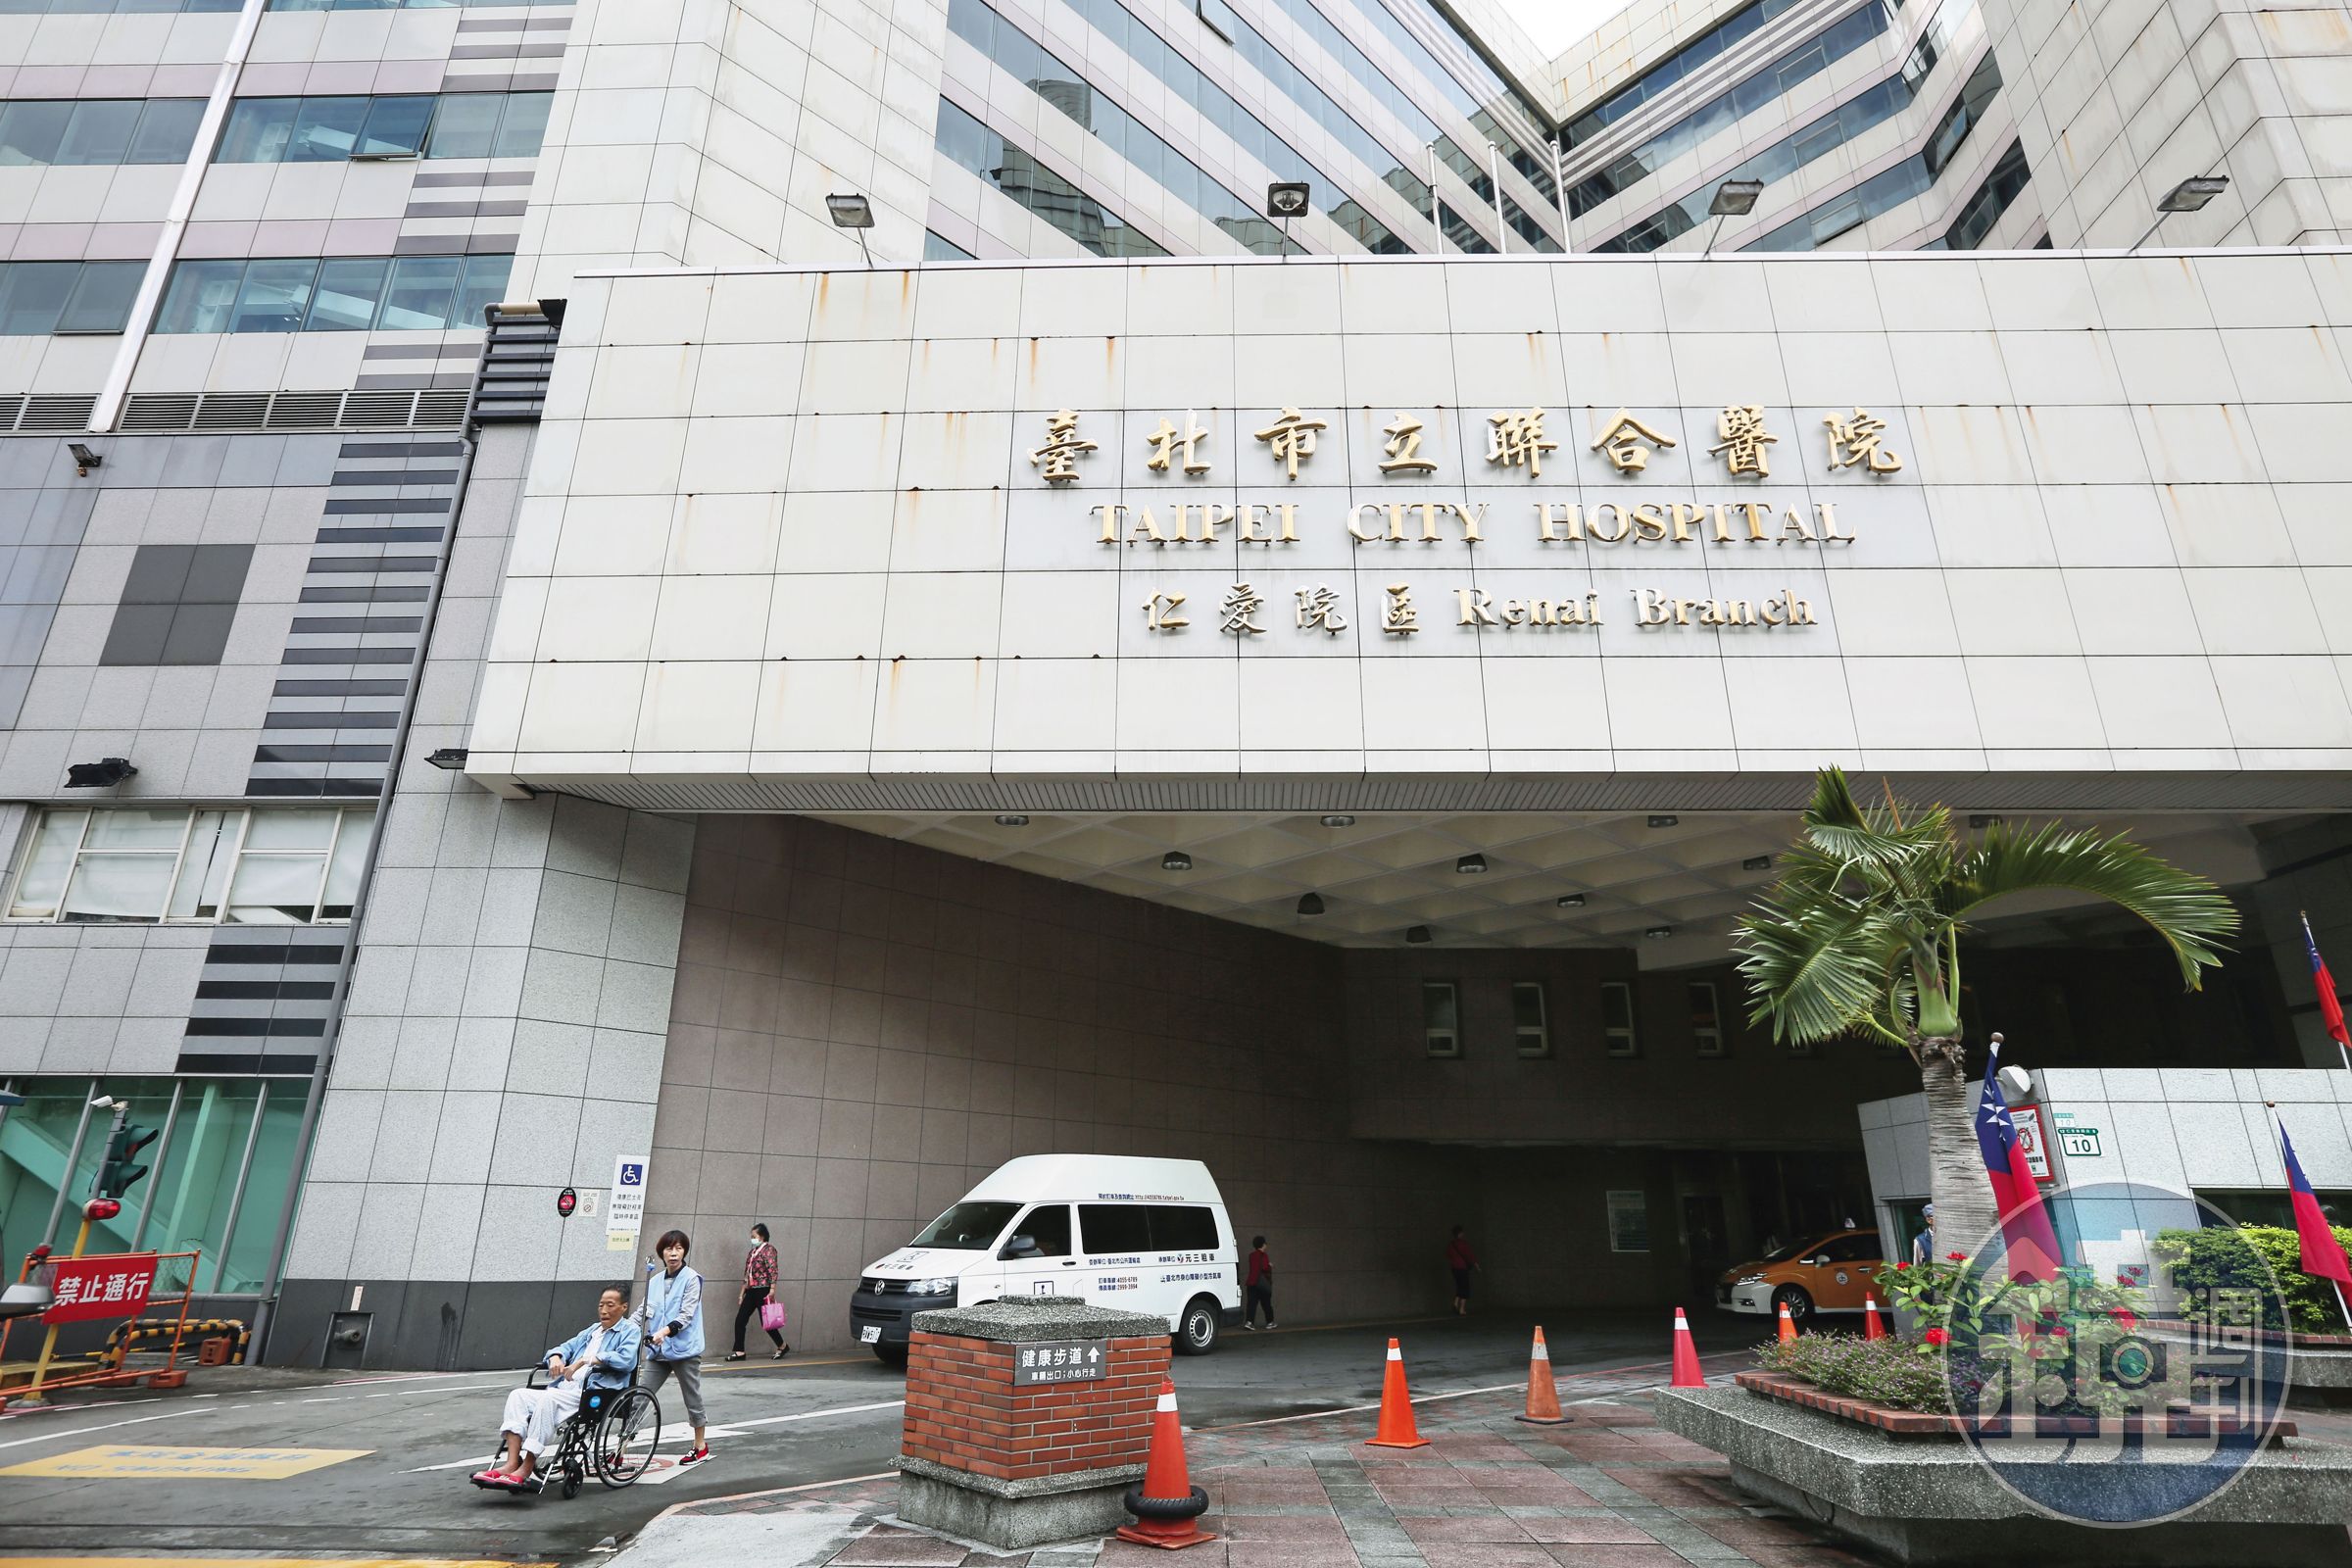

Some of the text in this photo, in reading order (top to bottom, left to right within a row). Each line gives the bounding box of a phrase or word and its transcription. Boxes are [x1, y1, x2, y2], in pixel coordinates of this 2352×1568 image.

[1027, 405, 1903, 483] 臺北市立聯合醫院
[1089, 501, 1857, 546] TAIPEI CITY HOSPITAL
[1141, 581, 1819, 636] 仁愛院區 Renai Branch
[2072, 1139, 2091, 1152] 10
[55, 1272, 150, 1306] 禁止通行
[1022, 1347, 1082, 1368] 健康步道
